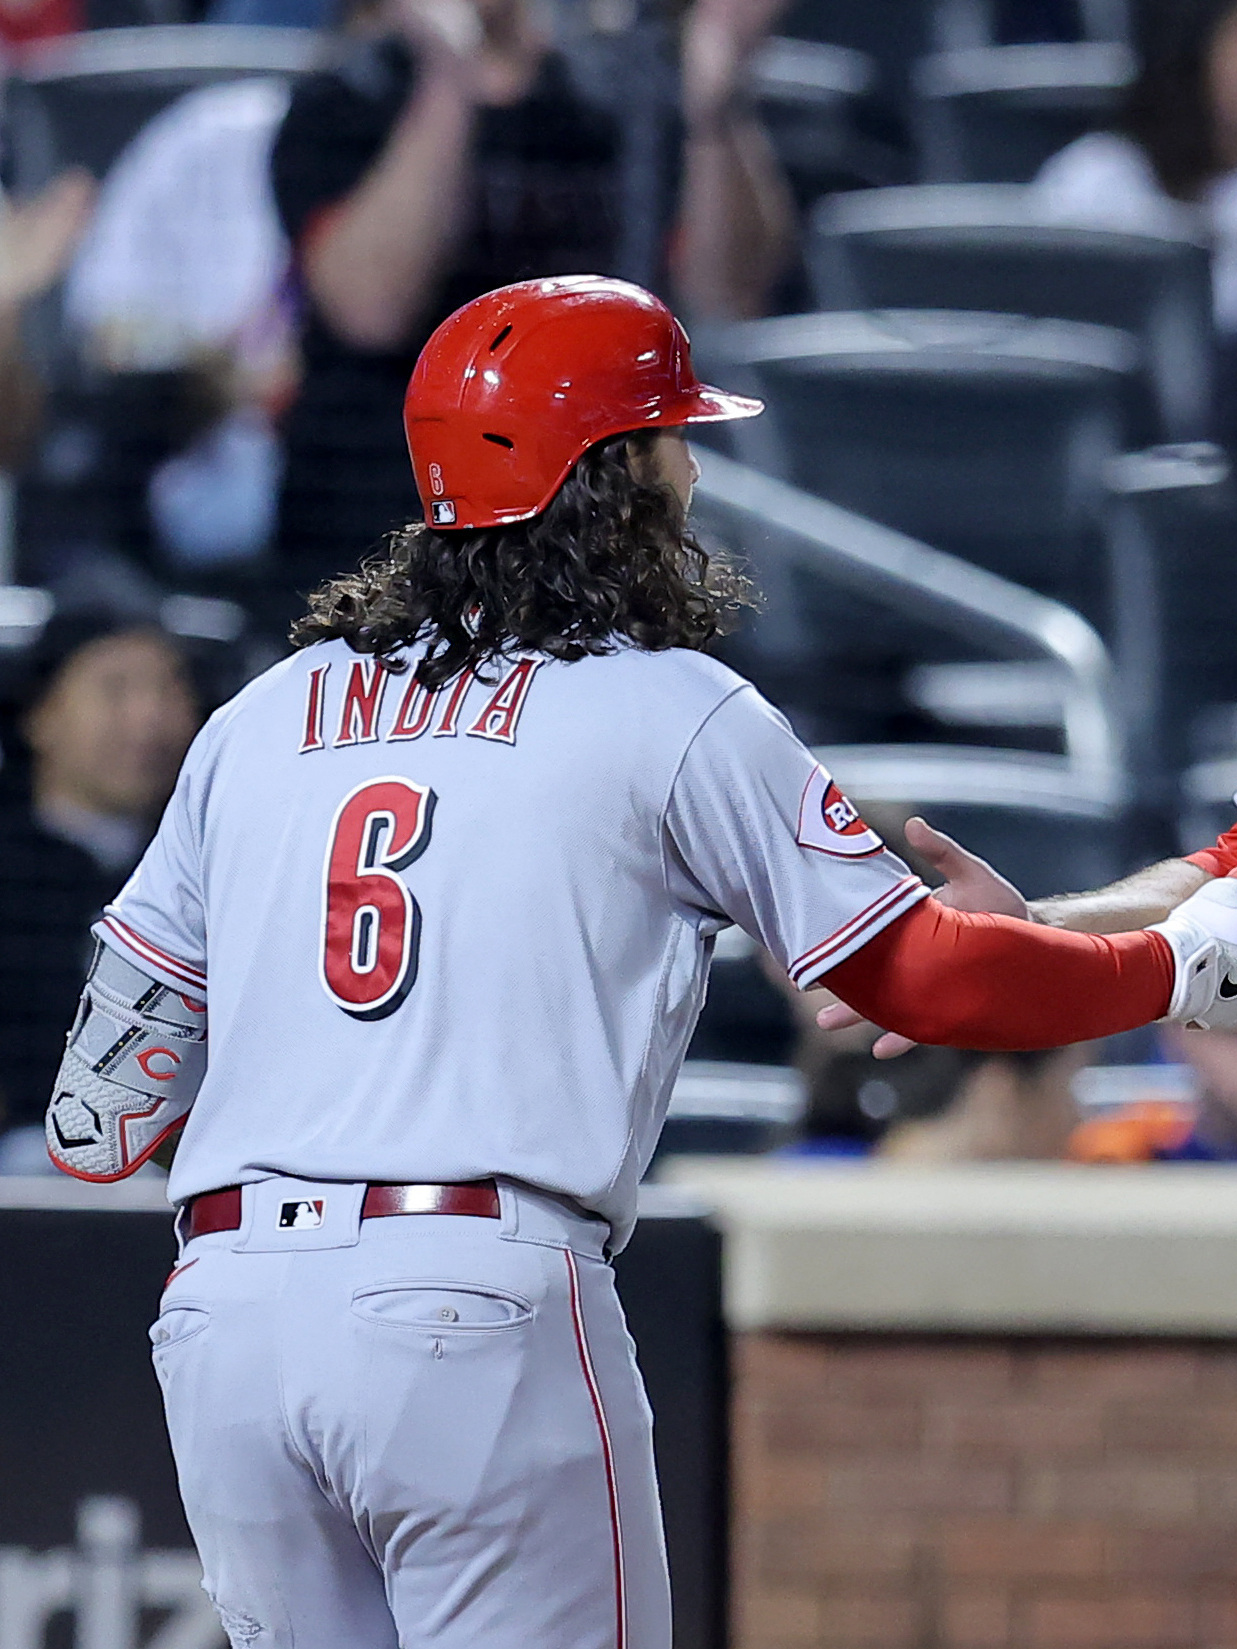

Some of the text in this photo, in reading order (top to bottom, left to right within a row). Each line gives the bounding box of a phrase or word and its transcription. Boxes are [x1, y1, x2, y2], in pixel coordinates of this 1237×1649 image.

[428, 462, 444, 496] 6
[298, 653, 545, 754] INDIA
[318, 774, 439, 1022] 6
[136, 1046, 182, 1081] C
